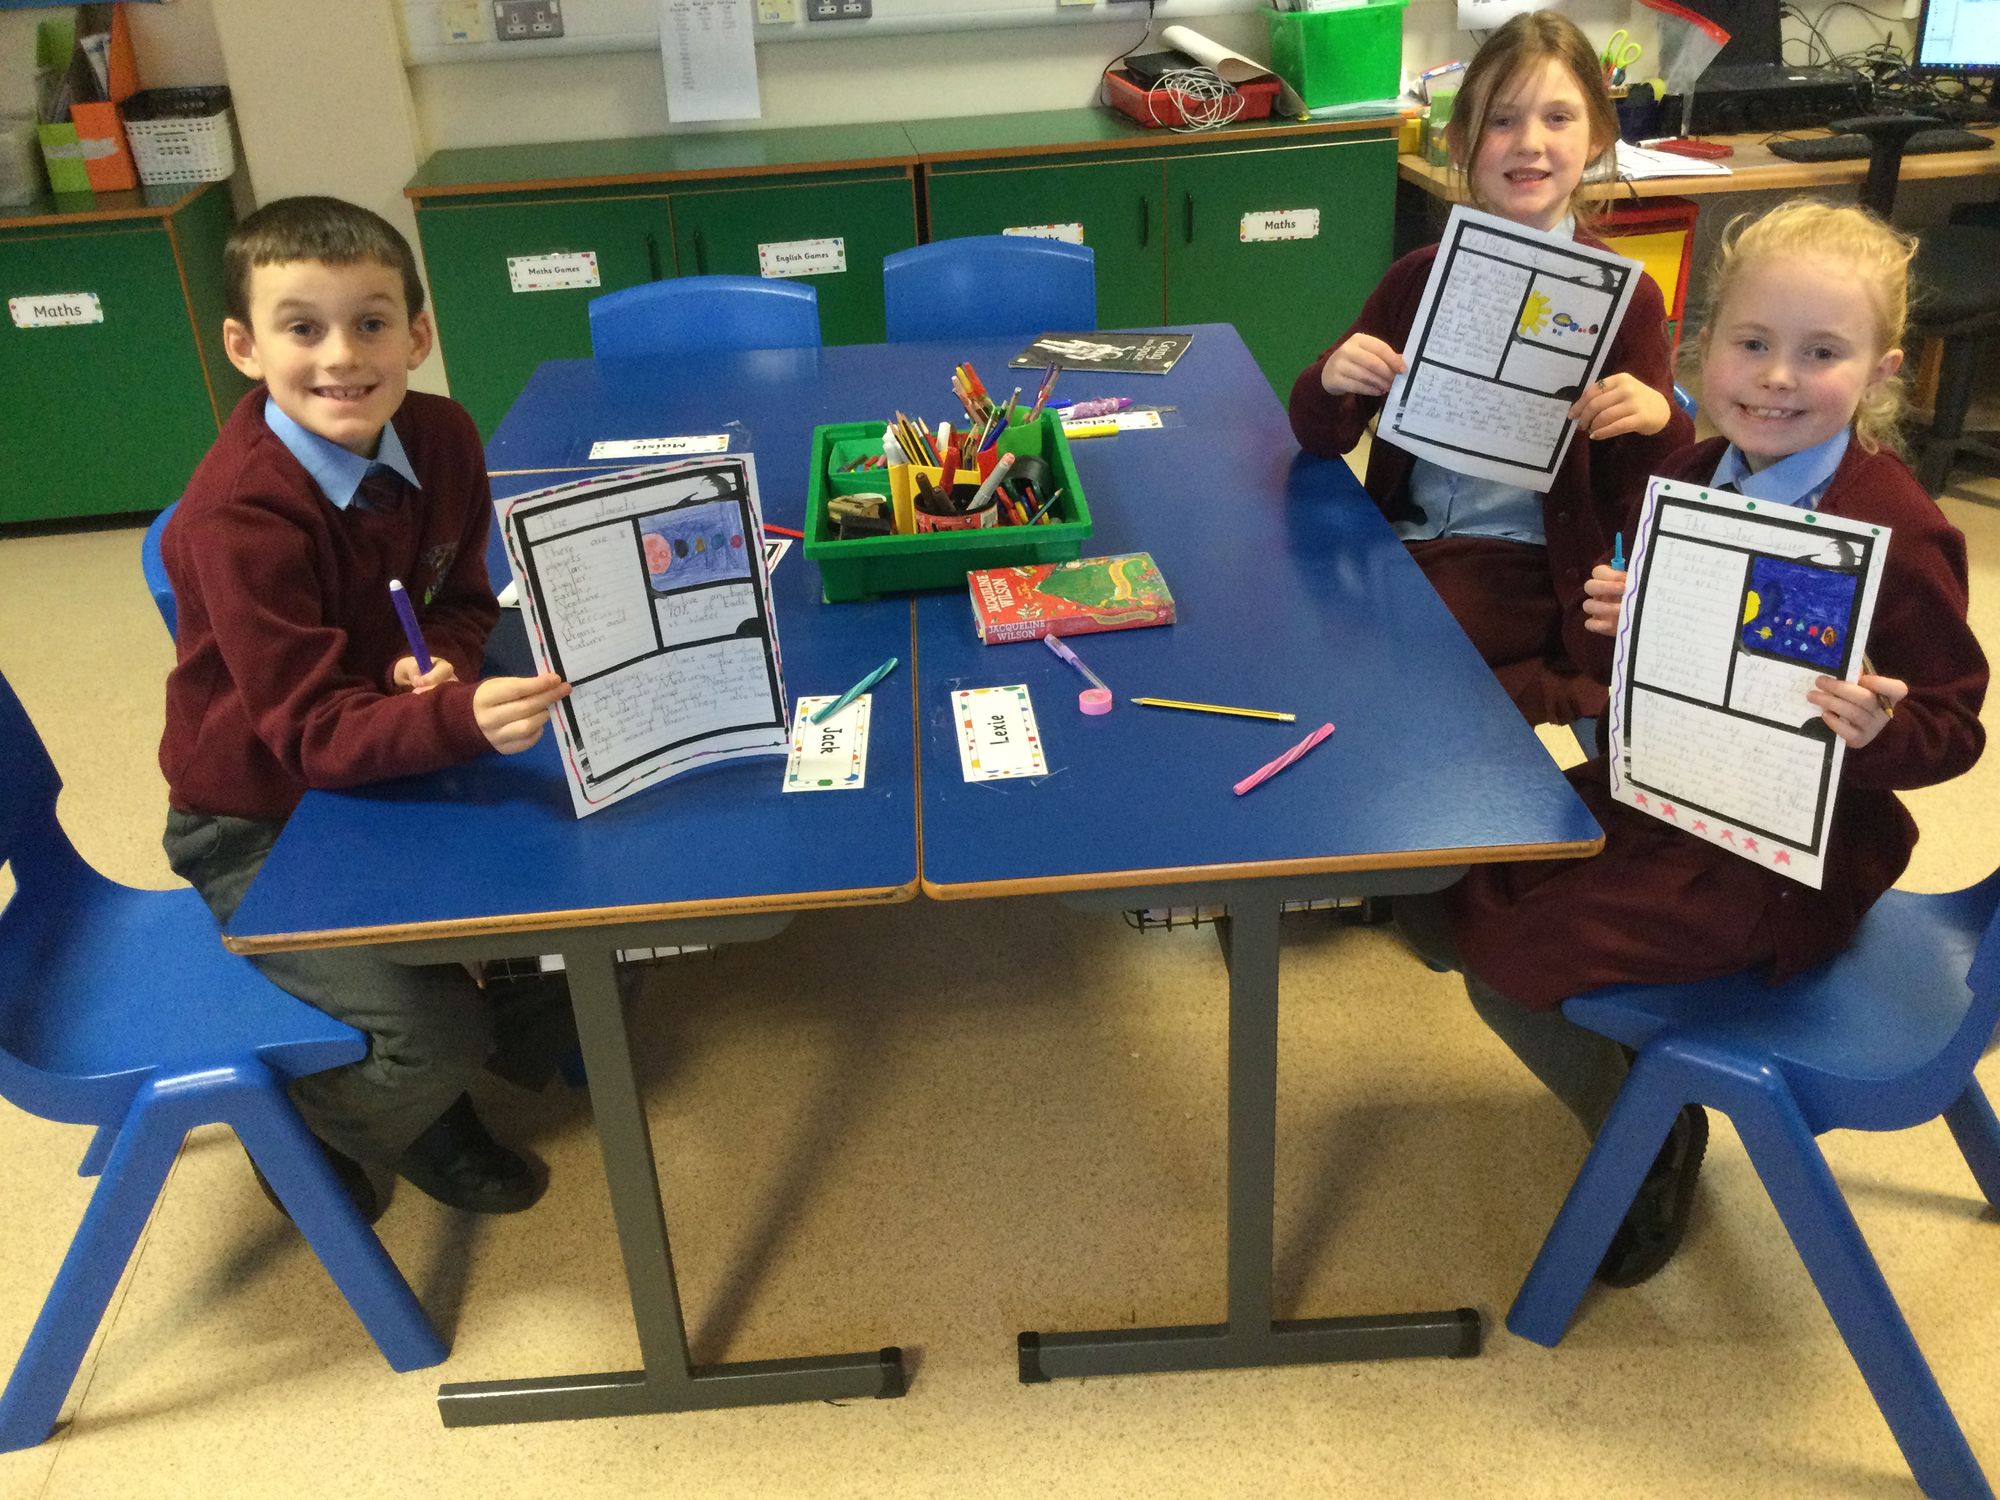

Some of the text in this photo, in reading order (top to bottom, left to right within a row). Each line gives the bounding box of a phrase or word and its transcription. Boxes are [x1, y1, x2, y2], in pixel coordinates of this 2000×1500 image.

[1264, 219, 1297, 231] Maths
[776, 252, 830, 264] English Games
[527, 266, 581, 276] Maths Games
[33, 302, 83, 319] Maths
[632, 442, 687, 451] Maisie
[975, 574, 1002, 614] JACQUELINE
[991, 577, 1015, 609] WILSON
[988, 620, 1046, 634] JACQUELINE
[996, 629, 1037, 642] WILSON
[987, 715, 1010, 745] Lexie
[820, 727, 843, 755] Jack
